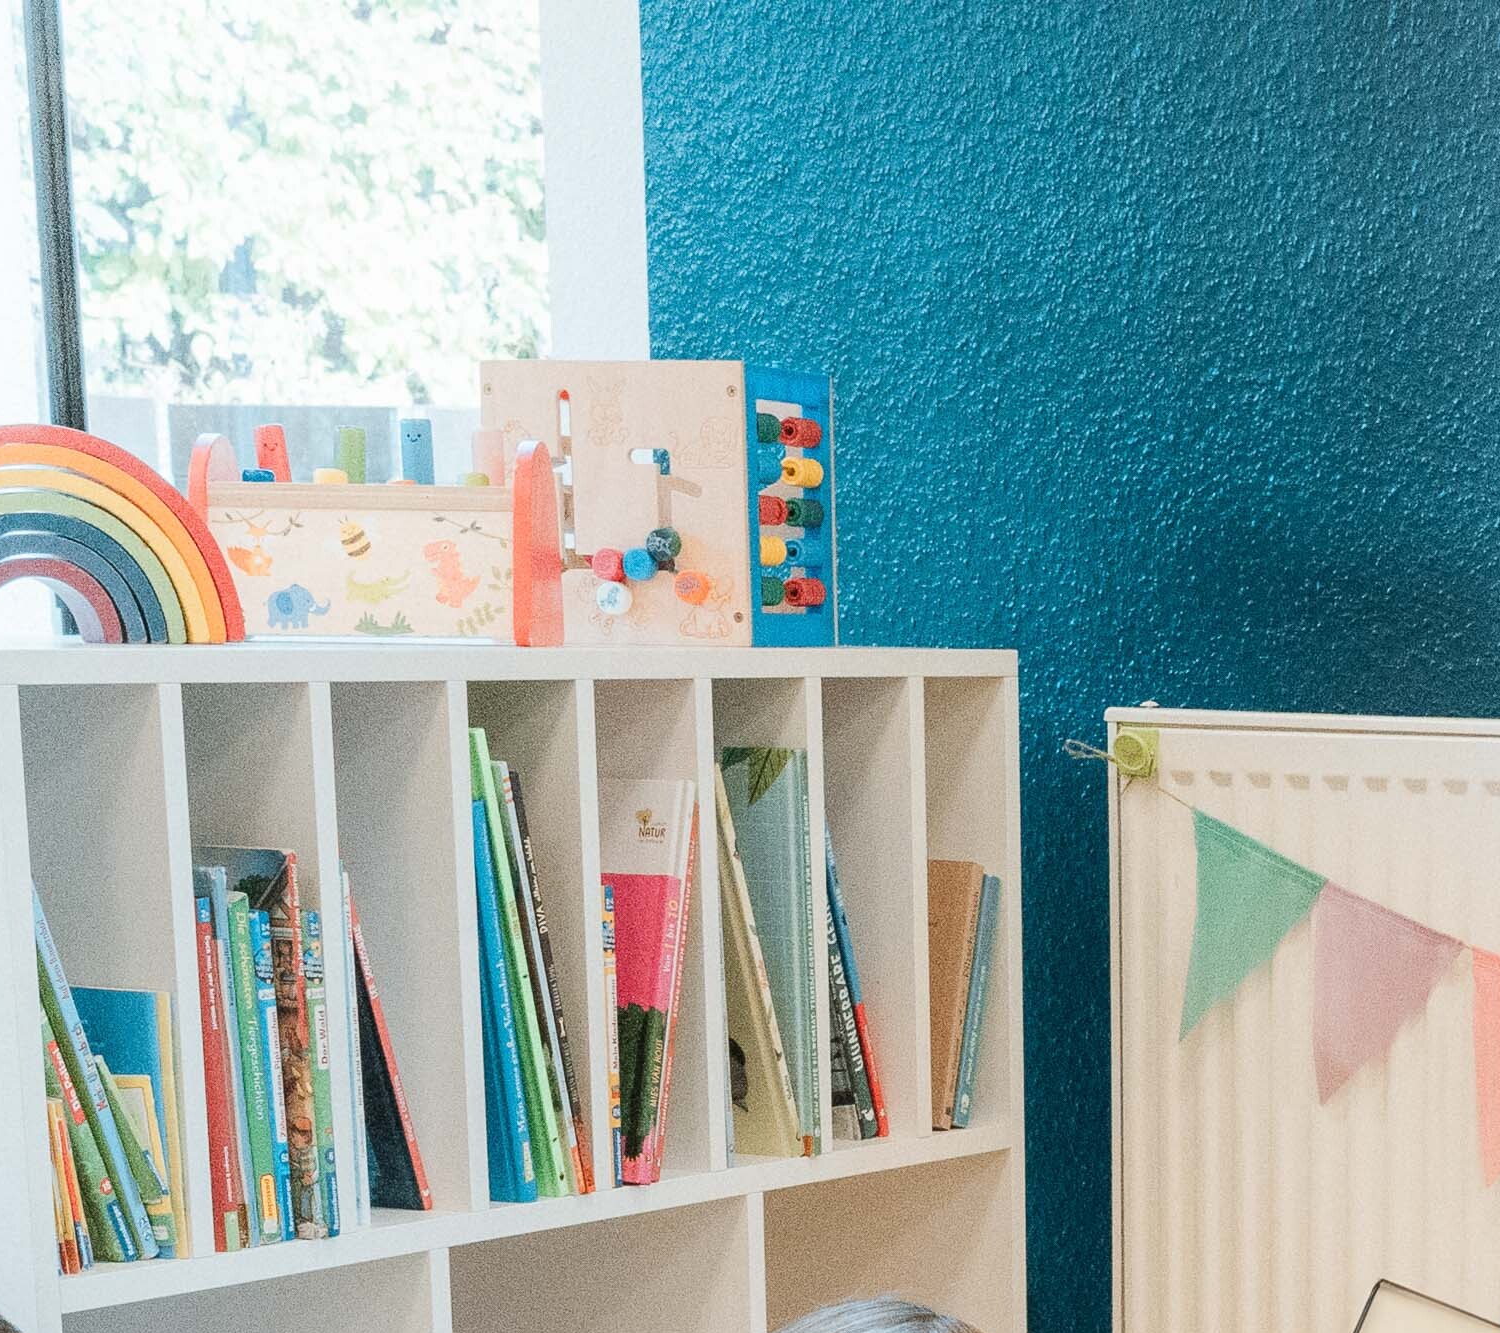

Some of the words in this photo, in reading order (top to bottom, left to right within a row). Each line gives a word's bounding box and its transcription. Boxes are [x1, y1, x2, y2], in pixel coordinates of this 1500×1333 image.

[638, 826, 667, 838] NATUR
[536, 905, 548, 934] DIVA
[666, 899, 678, 918] 10
[235, 911, 247, 935] Die
[250, 1017, 264, 1121] Tiergeschichten
[611, 978, 619, 1045] Kindergarten
[829, 952, 864, 1072] WUNDERBARE
[273, 1052, 281, 1070] Pipi
[653, 1038, 663, 1062] HOUT
[52, 1047, 72, 1090] Polizei
[651, 1064, 660, 1083] VAN
[68, 1089, 80, 1111] Die
[649, 1086, 658, 1107] MIES
[516, 1103, 526, 1132] Mein
